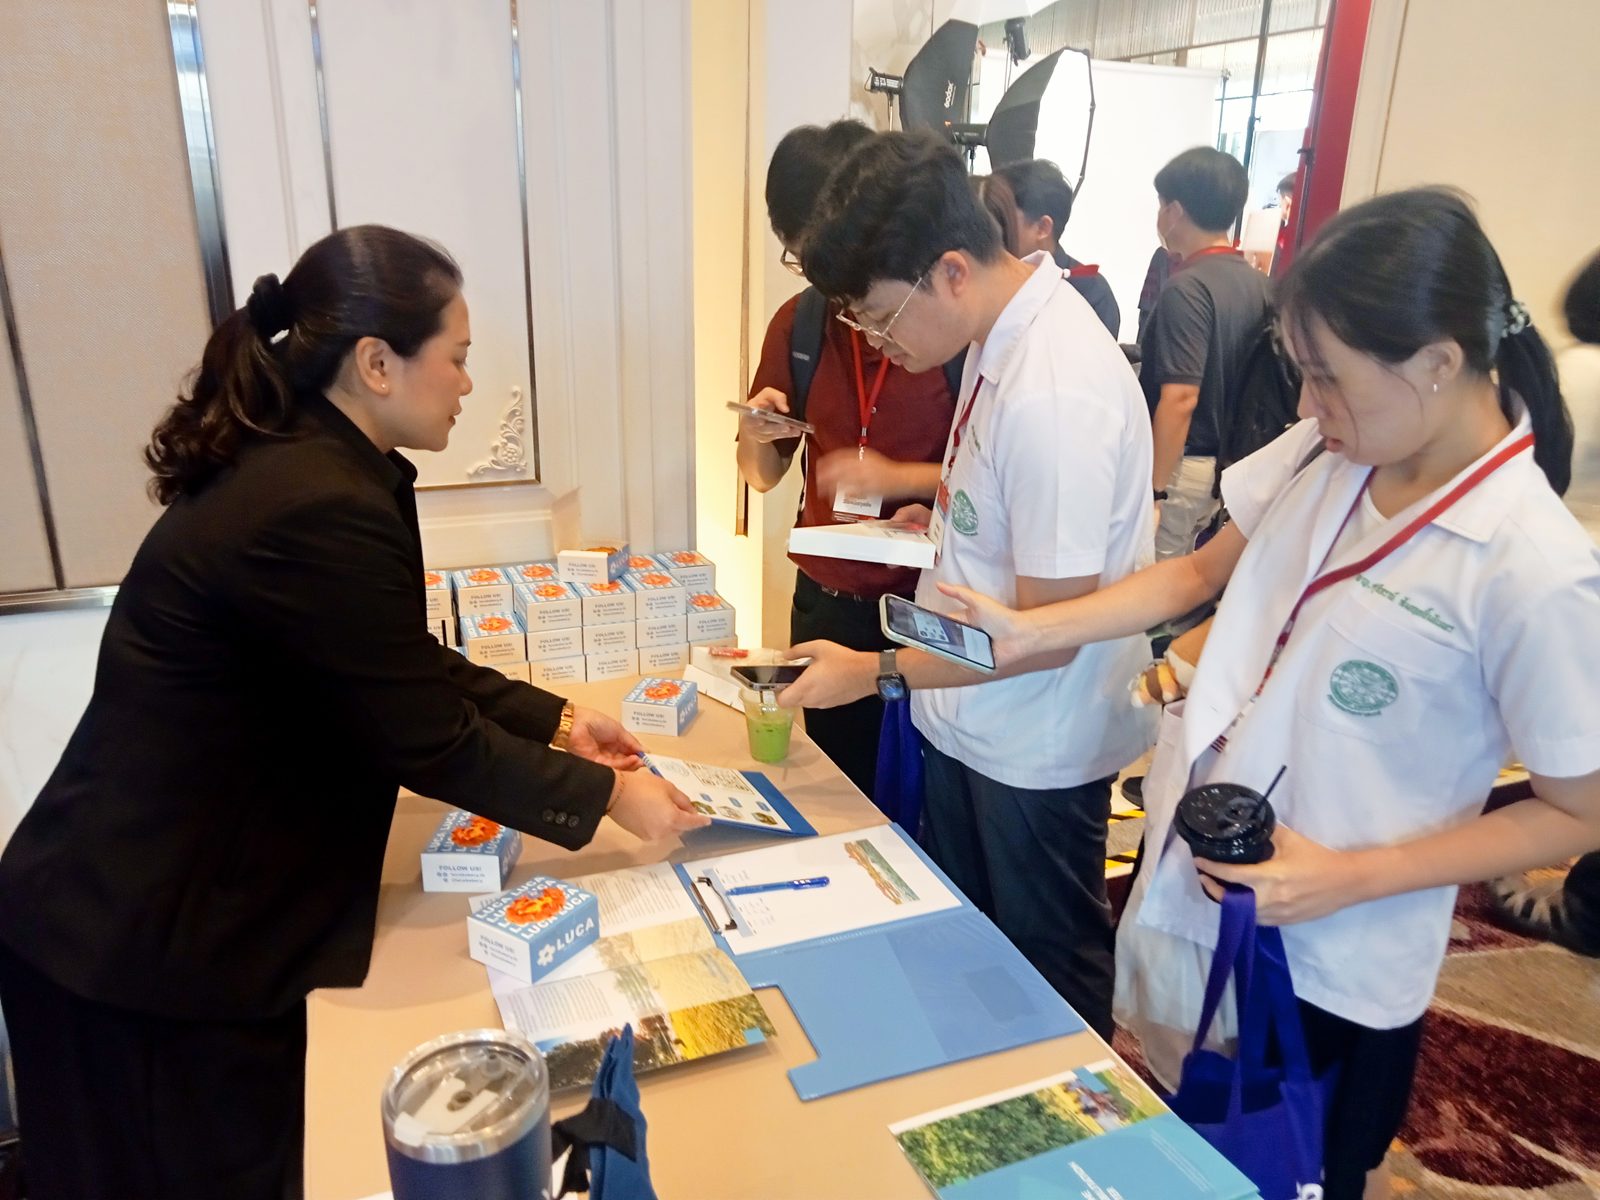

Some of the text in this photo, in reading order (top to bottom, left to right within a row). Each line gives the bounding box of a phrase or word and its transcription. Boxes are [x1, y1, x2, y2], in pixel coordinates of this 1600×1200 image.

[476, 897, 512, 919] LUCA
[511, 876, 546, 896] LUCA
[521, 892, 591, 940] LUCA LUCA
[556, 917, 595, 951] LUCA
